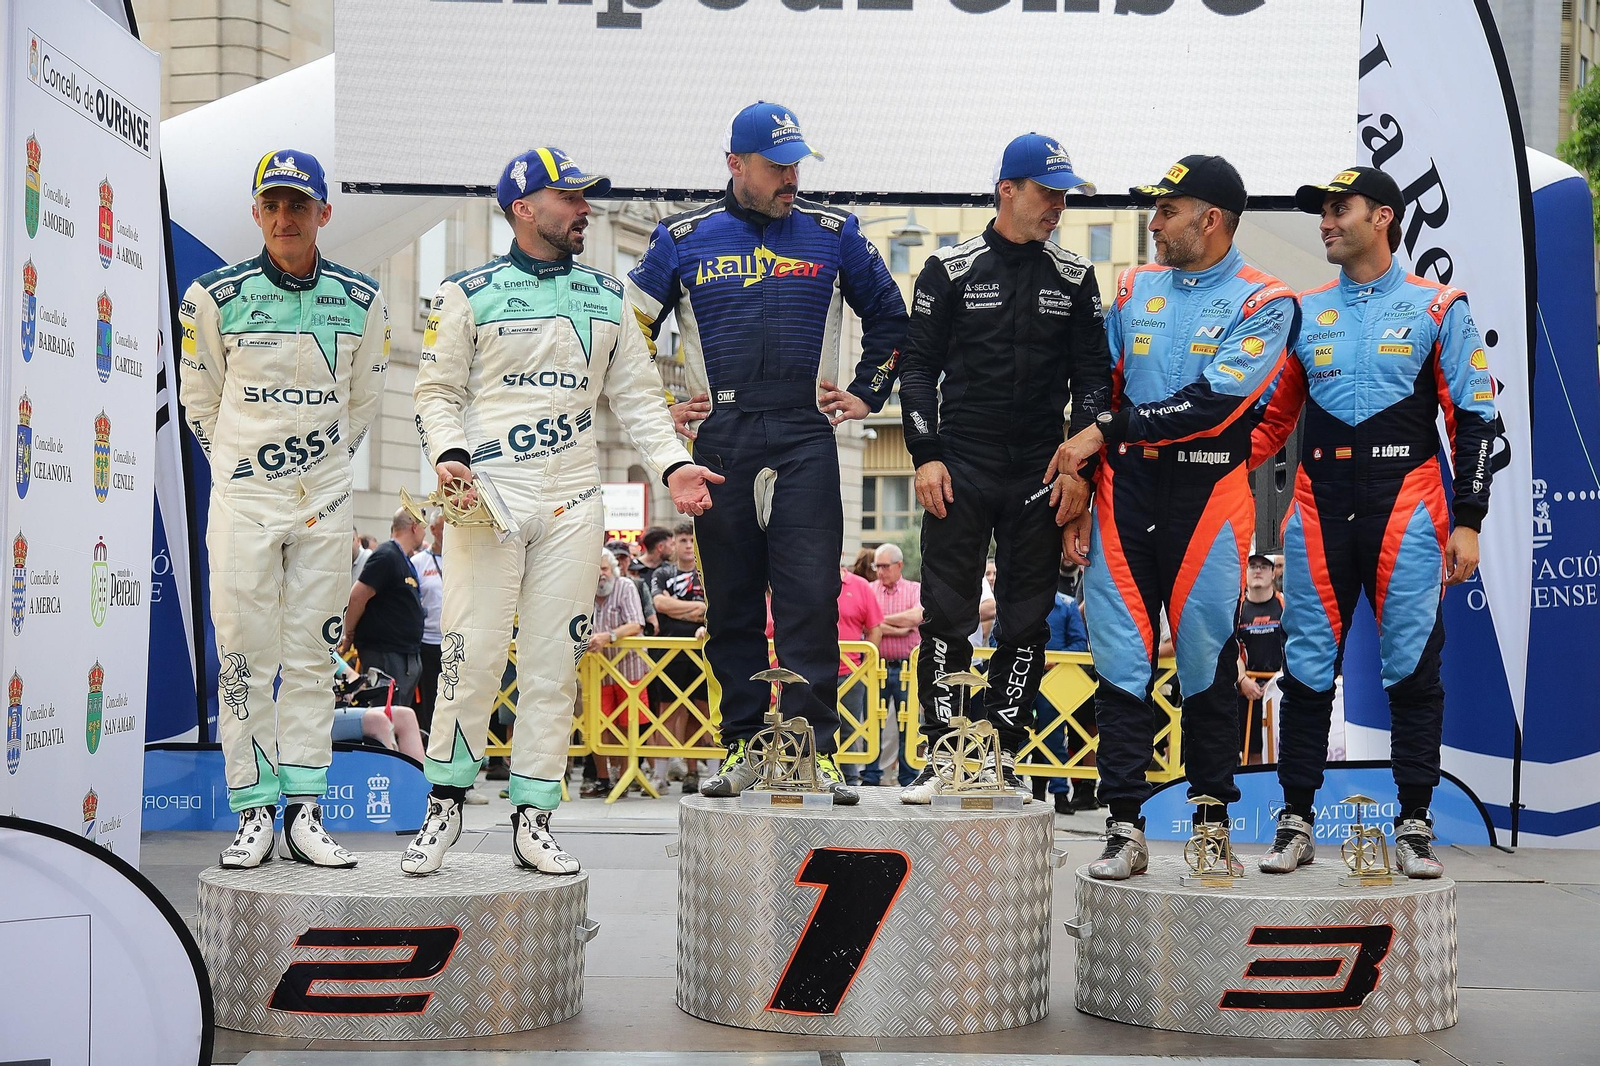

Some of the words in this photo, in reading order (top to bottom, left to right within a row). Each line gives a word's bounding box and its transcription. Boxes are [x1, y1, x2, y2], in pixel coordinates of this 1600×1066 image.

[43, 54, 81, 105] Concello
[84, 84, 94, 113] de
[96, 88, 149, 152] OURENSE
[264, 170, 310, 182] MICHELIN
[43, 182, 64, 204] Concello
[43, 209, 75, 239] AMOEIRO
[116, 219, 132, 239] Concello
[673, 223, 693, 238] OMP
[820, 216, 840, 230] OMP
[116, 244, 121, 261] A
[121, 246, 143, 271] ARNOIA
[948, 259, 968, 273] OMP
[1061, 266, 1082, 279] OMP
[466, 276, 487, 291] OMP
[503, 278, 541, 292] Enerthy
[572, 283, 600, 294] TURINI
[602, 278, 622, 293] OMP
[215, 285, 236, 301] OMP
[250, 292, 285, 304] Enerthy
[318, 296, 345, 306] TURINI
[350, 287, 371, 303] OMP
[181, 302, 197, 318] OMP
[582, 301, 609, 312] Asturias
[1202, 307, 1233, 315] HYUNDAI
[1383, 310, 1419, 318] HYUNDAI
[40, 305, 61, 325] Concello
[326, 314, 351, 325] Asturias
[511, 326, 539, 334] MICHELIN
[1131, 318, 1166, 329] cetelem
[39, 331, 75, 358] BARBADÁS
[115, 331, 132, 349] Concello
[249, 339, 279, 347] MICHELIN
[1135, 336, 1151, 345] RACC
[1307, 330, 1346, 344] cetelem
[1315, 348, 1333, 356] RACC
[1381, 346, 1410, 354] PIRELLI
[115, 355, 143, 378] CARTELLE
[502, 371, 590, 391] SKODA
[244, 386, 340, 405] SKODA
[717, 391, 736, 402] OMP
[508, 413, 573, 453] GSS
[35, 435, 56, 453] Concello
[257, 430, 326, 472] GSS
[551, 439, 578, 457] Services
[1372, 446, 1381, 458] P.
[1382, 443, 1410, 458] LÓPEZ
[113, 448, 130, 465] Concello
[1177, 451, 1188, 462] D.
[1189, 449, 1231, 465] VÁZQUEZ
[1475, 439, 1489, 480] HYUNDAI
[34, 461, 72, 483] CELANOVA
[113, 472, 134, 491] CENLLE
[30, 570, 53, 586] Concello
[110, 572, 141, 606] Pereiro
[29, 597, 35, 614] A
[36, 596, 61, 613] MERCA
[106, 693, 122, 710] Concello
[26, 703, 47, 722] Concello
[104, 718, 116, 738] SAN
[116, 715, 136, 736] AMARO
[26, 728, 65, 751] RIBADAVIA
[765, 846, 912, 1016] 1
[268, 926, 463, 1015] 2
[1219, 925, 1395, 1012] 3
